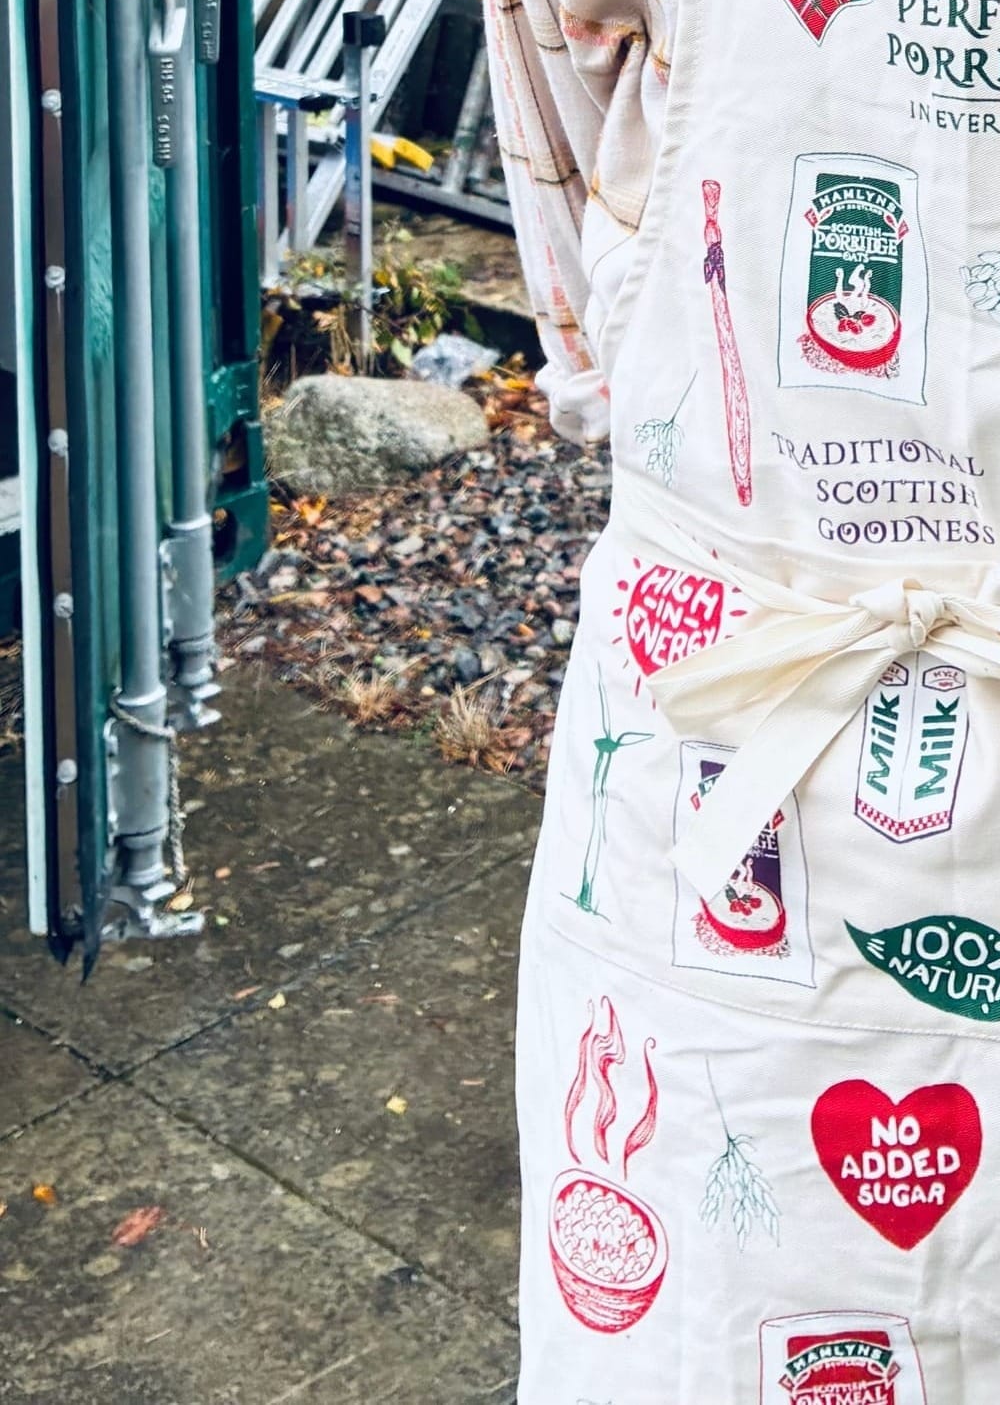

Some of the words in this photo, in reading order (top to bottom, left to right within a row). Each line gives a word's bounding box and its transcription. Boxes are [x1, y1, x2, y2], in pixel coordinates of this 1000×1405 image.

[910, 100, 930, 123] IN
[819, 188, 897, 213] HAMLYNS
[814, 231, 898, 256] PORRIDGE
[831, 223, 882, 237] SCOTTISH
[843, 252, 869, 263] OATS
[771, 431, 985, 477] TRADITIONAL
[816, 478, 979, 508] SCOTTISH
[818, 515, 996, 545] GOODNESS
[640, 568, 720, 622] HIGH
[866, 692, 901, 795] Milk
[914, 696, 961, 801] Milk
[871, 1115, 921, 1148] NO
[841, 1146, 961, 1180] ADDED
[857, 1182, 946, 1208] SUGAR
[792, 1343, 883, 1372] HAMLYNS
